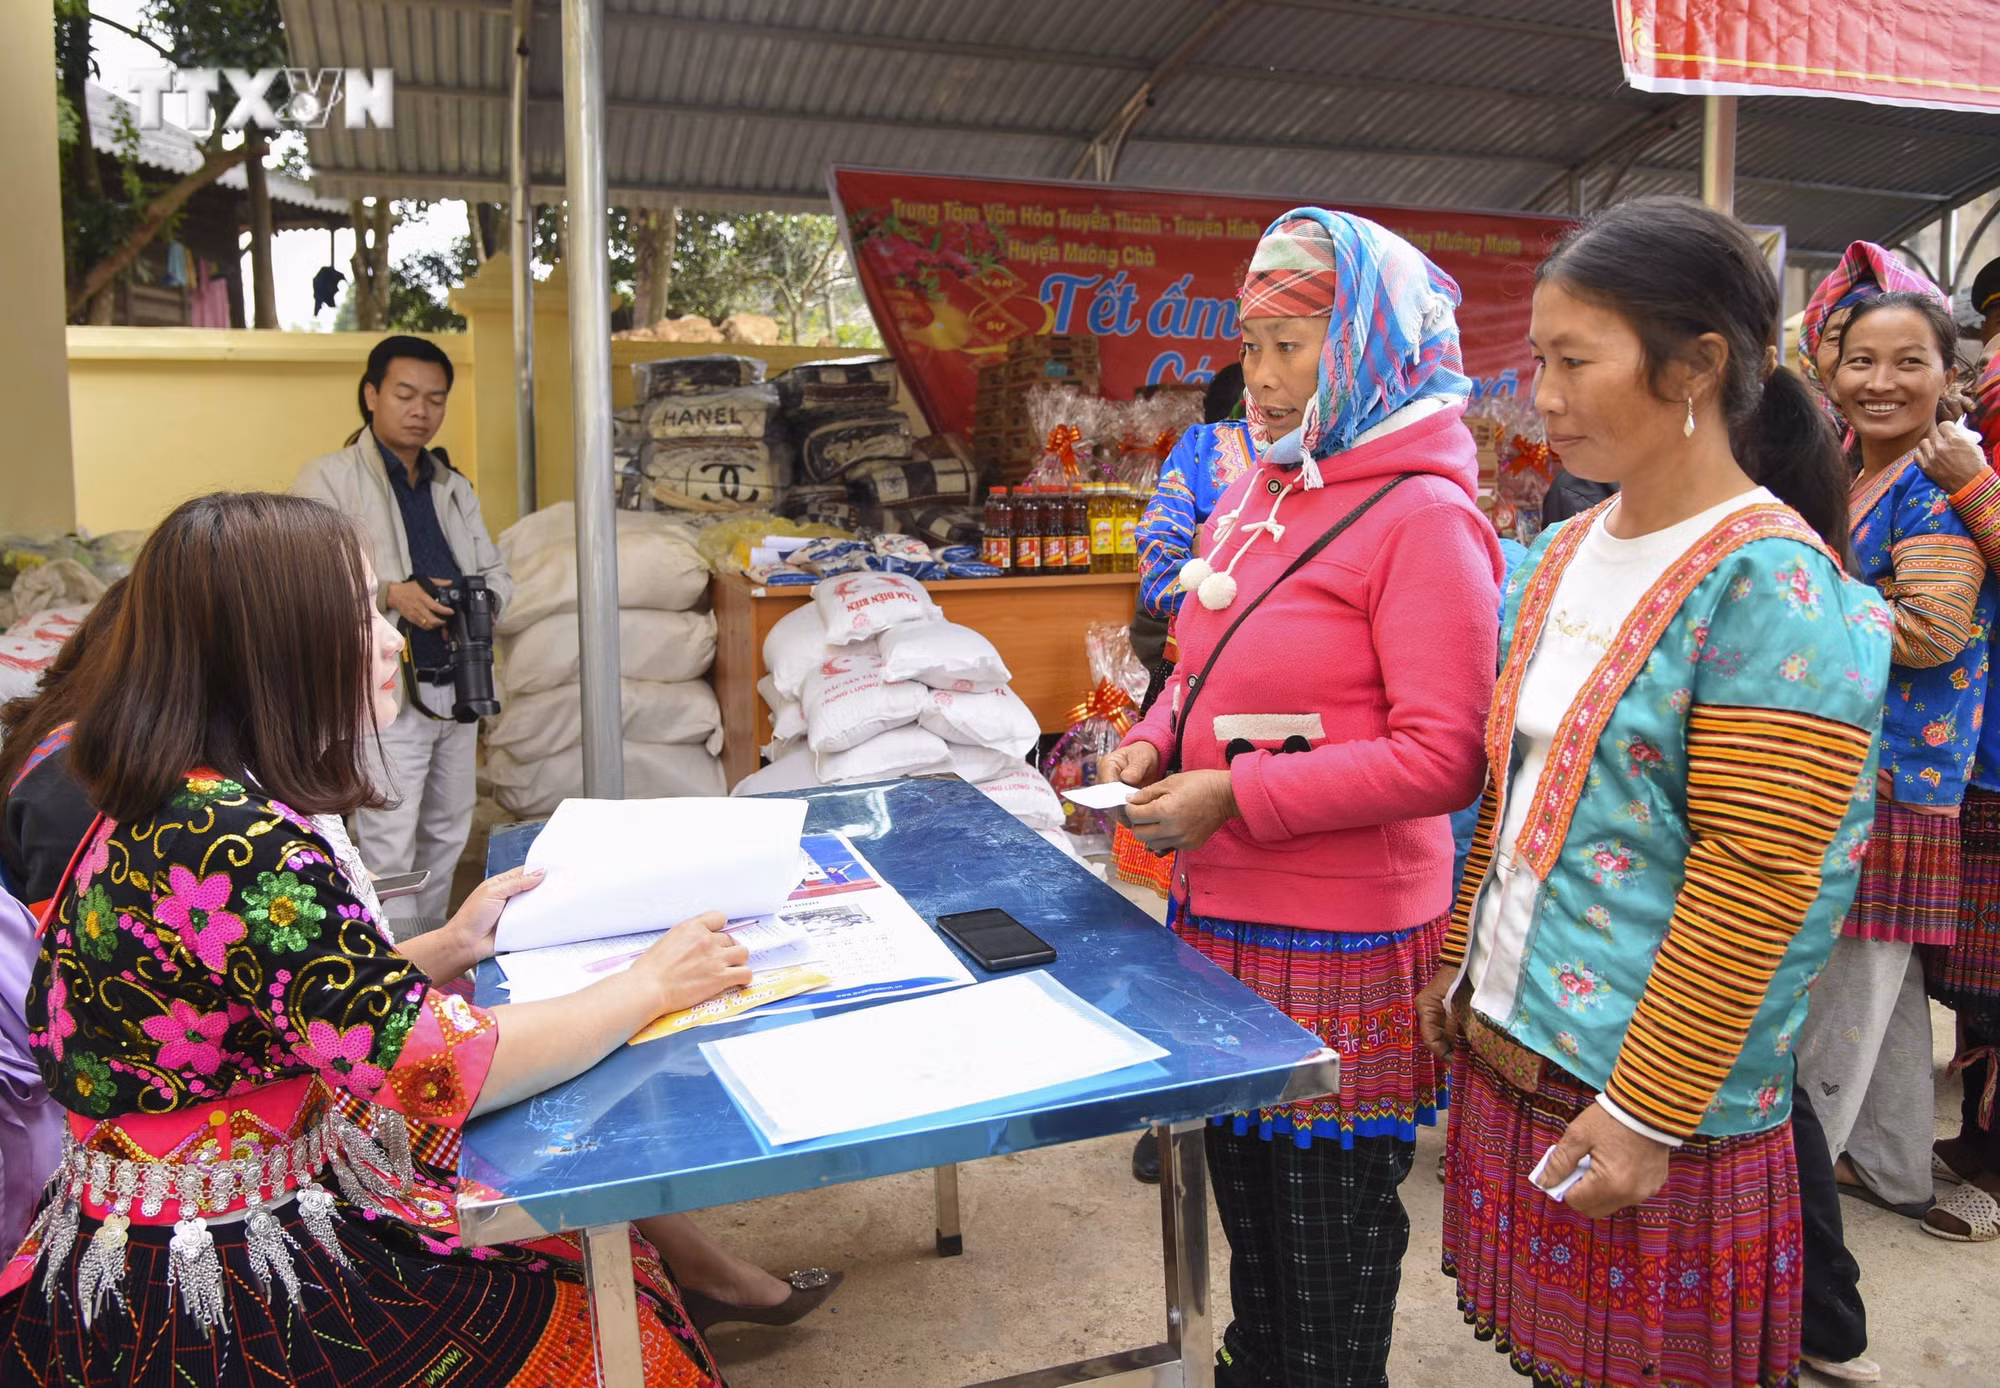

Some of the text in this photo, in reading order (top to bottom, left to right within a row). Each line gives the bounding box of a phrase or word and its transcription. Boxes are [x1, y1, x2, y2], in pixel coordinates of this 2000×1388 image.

[892, 198, 939, 225] Trung
[943, 201, 979, 222] Tâm
[1115, 211, 1162, 235] Thanh
[1039, 270, 1241, 341] Tết ấm
